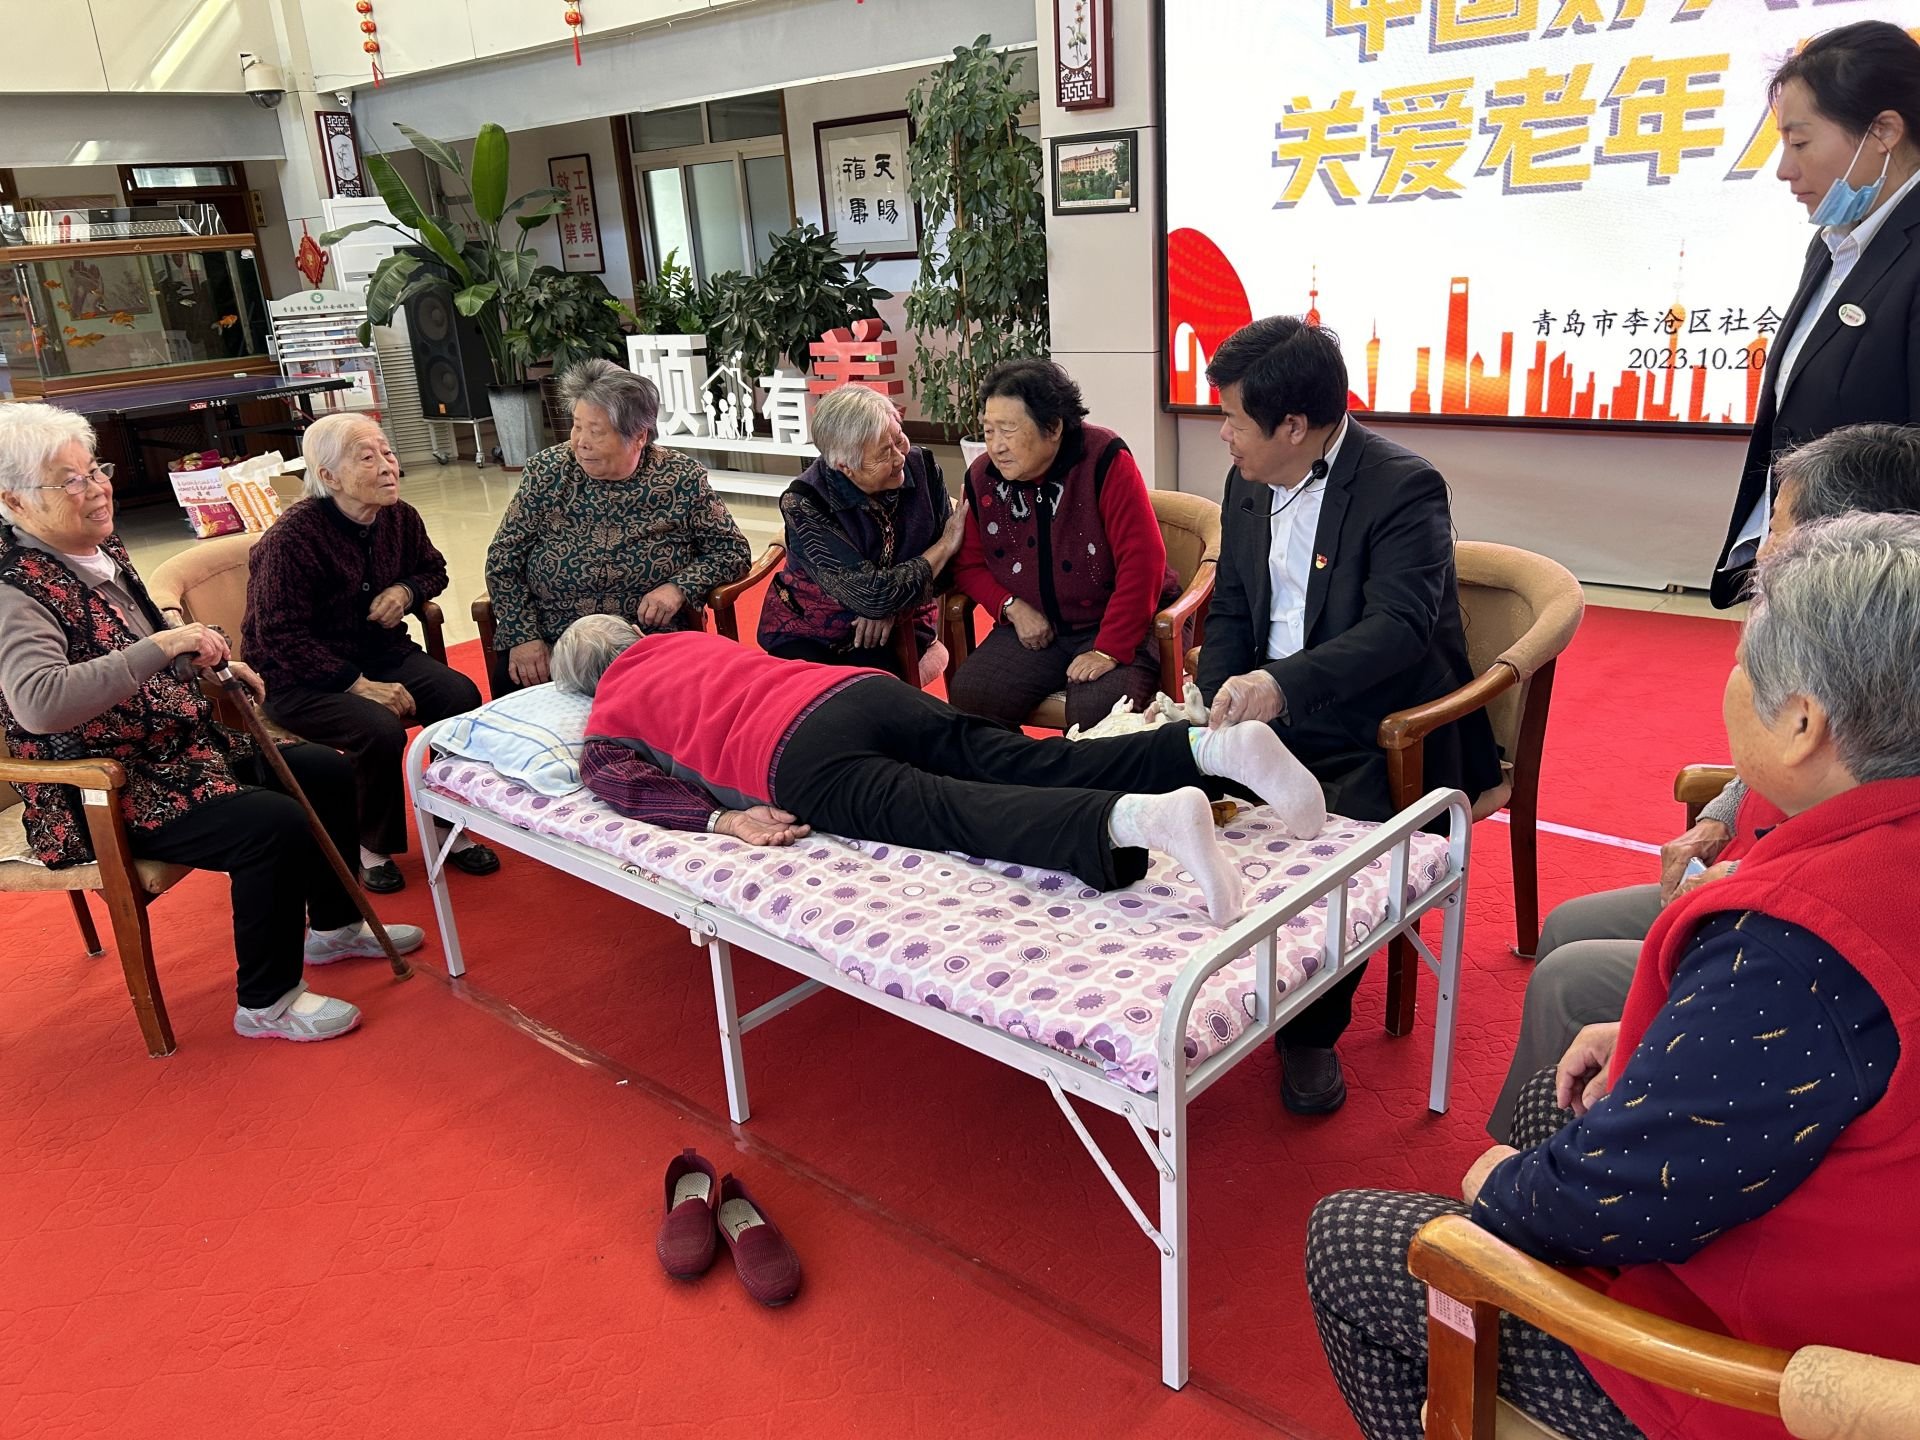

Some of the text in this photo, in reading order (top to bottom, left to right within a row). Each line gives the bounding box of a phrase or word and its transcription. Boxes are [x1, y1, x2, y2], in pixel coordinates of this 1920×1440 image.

[1273, 54, 1784, 210] 关爱老年
[1532, 305, 1783, 337] 青岛市李沧区社会
[1628, 347, 1767, 370] 2023.10.20
